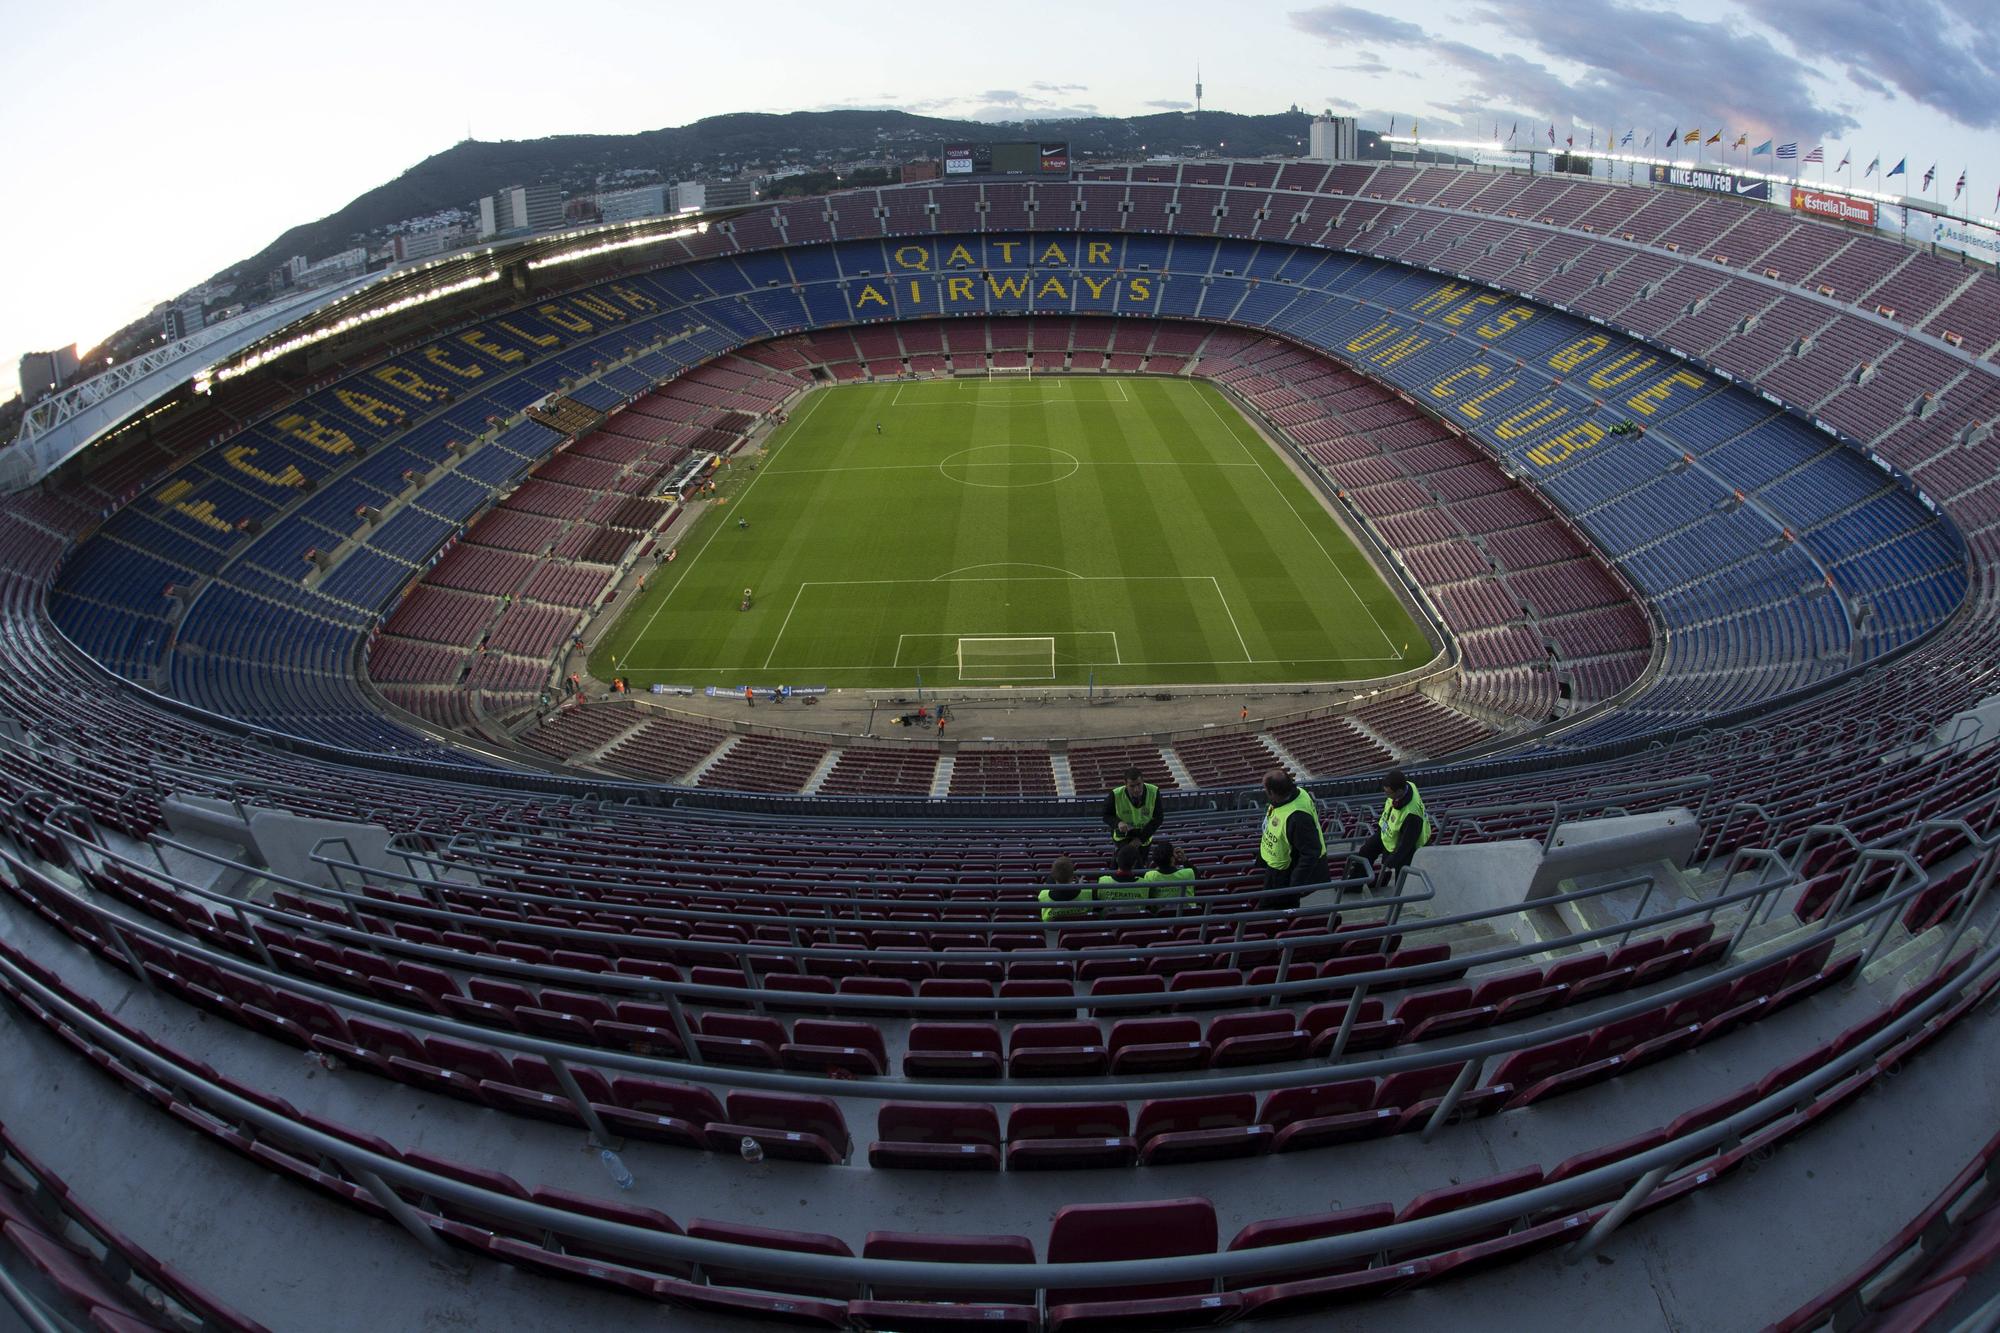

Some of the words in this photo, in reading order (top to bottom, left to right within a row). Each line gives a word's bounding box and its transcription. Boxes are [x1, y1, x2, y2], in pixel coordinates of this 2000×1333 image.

[1669, 168, 1731, 192] NIKE.COM/FCB
[1804, 193, 1838, 214] Estrella
[1839, 201, 1869, 220] Damm
[894, 242, 1112, 271] QATAR
[856, 275, 1151, 308] AIRWAYS
[275, 285, 659, 455] BARCELONA
[1547, 334, 1704, 416] QUE
[1346, 323, 1431, 367] UN
[1431, 363, 1605, 467] CLUB
